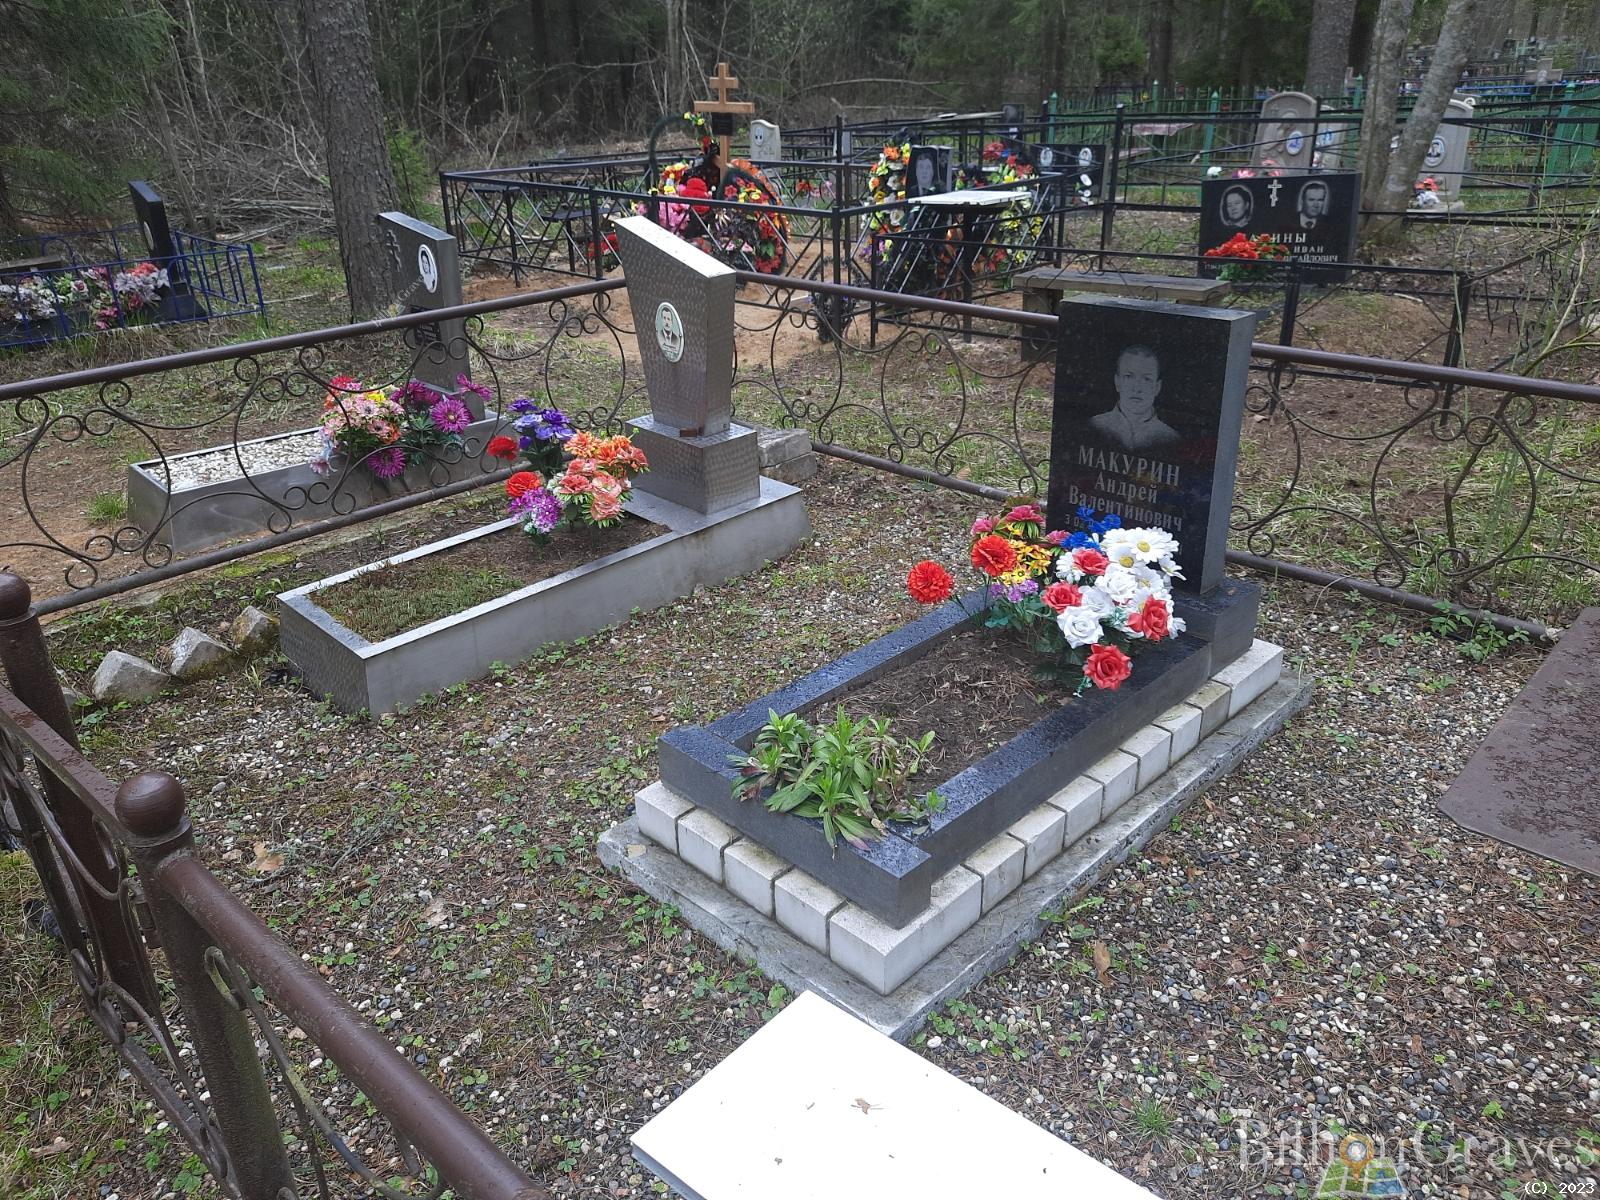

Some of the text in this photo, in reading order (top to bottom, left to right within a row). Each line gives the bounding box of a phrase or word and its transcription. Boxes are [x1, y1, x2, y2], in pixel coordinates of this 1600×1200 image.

[1247, 233, 1307, 244] АИНЫ
[1293, 245, 1324, 254] ИВАН
[1078, 445, 1180, 487] МАКУРИН
[1094, 471, 1158, 504] Андрей
[1068, 484, 1184, 533] Валентинович
